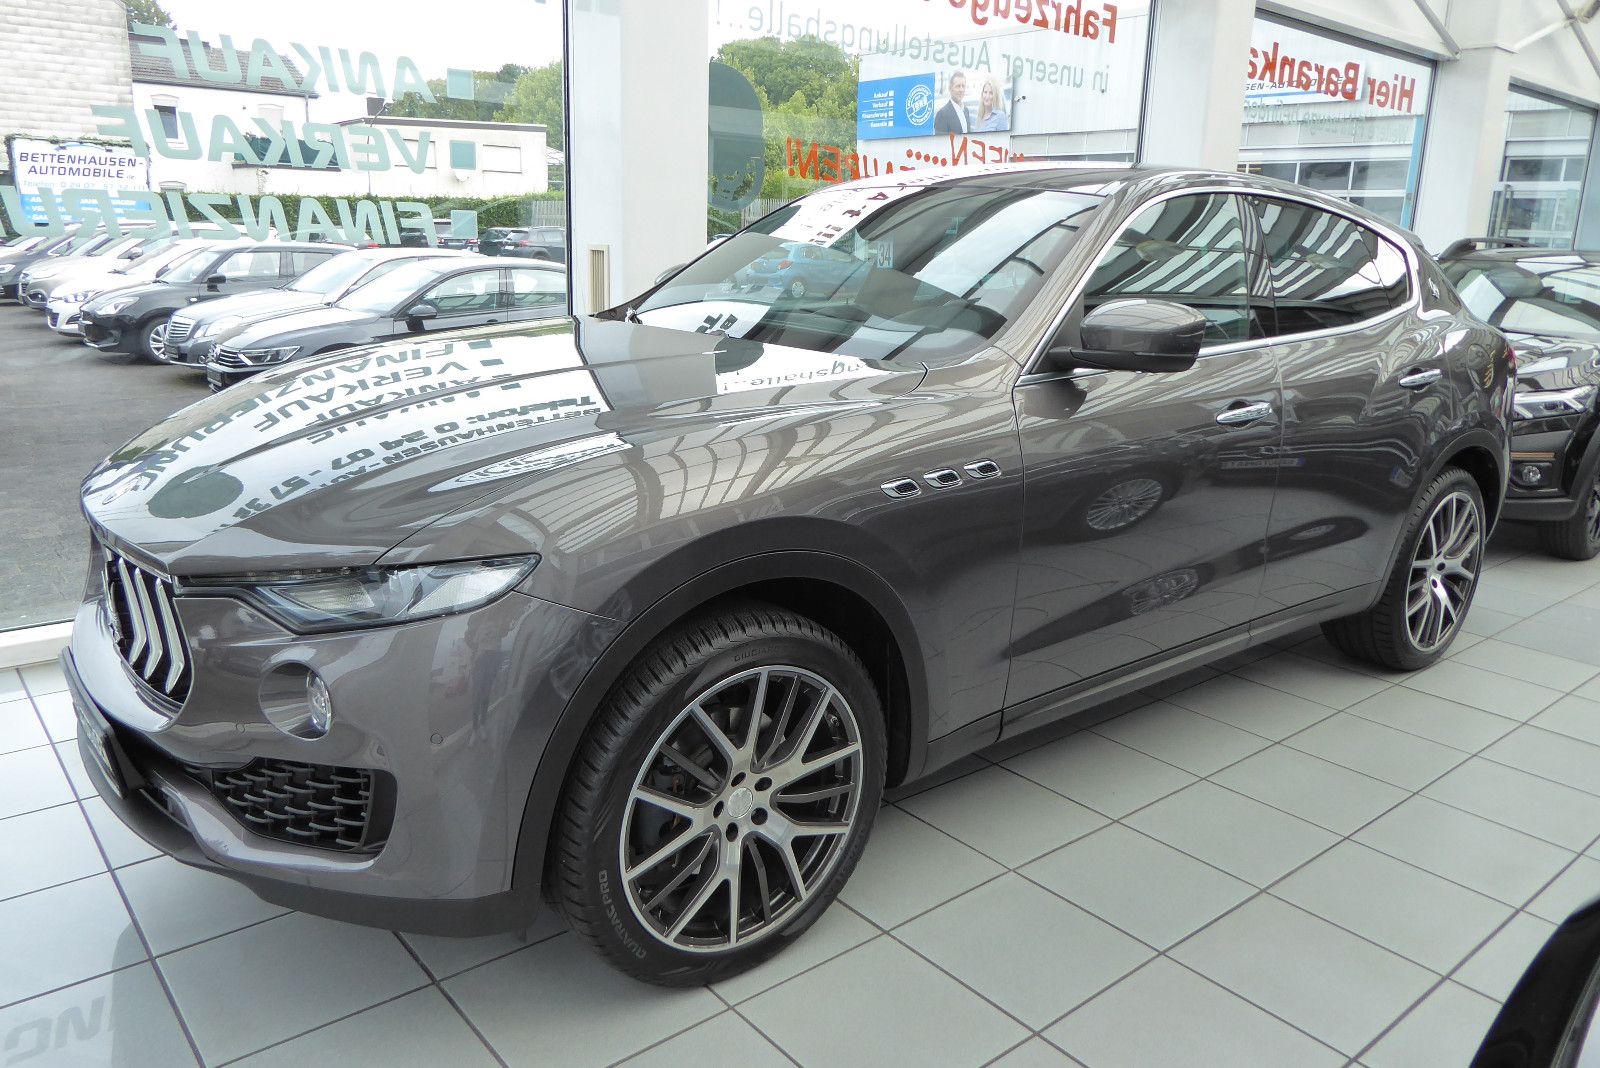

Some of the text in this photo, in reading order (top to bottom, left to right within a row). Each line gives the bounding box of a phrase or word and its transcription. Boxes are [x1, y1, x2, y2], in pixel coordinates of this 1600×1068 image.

[20, 152, 143, 167] BETTENHAUSEN-
[28, 165, 125, 179] AUTOMOBILE
[253, 361, 469, 433] VERKAUF
